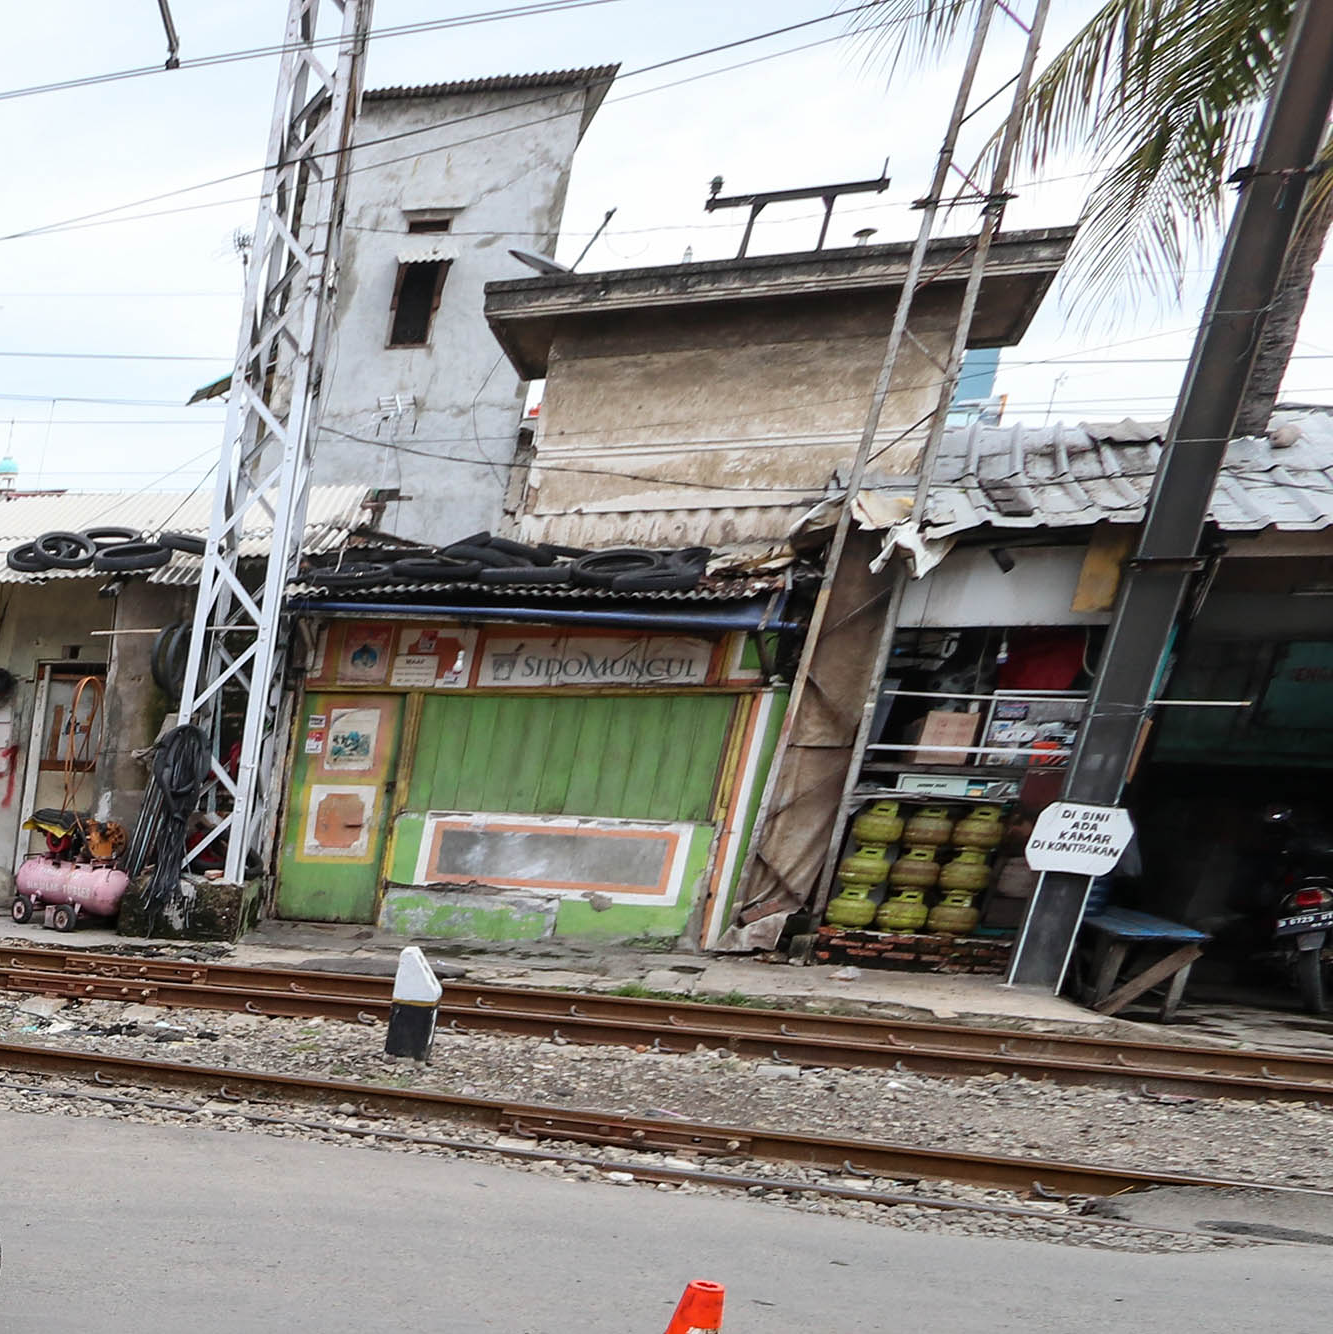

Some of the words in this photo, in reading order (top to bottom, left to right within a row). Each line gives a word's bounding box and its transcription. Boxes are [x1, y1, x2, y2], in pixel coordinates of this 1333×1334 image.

[1082, 812, 1111, 823] SINI
[1070, 821, 1099, 832] ADA
[1058, 830, 1113, 845] KAMAR
[1047, 842, 1120, 858] KONTRAKAN
